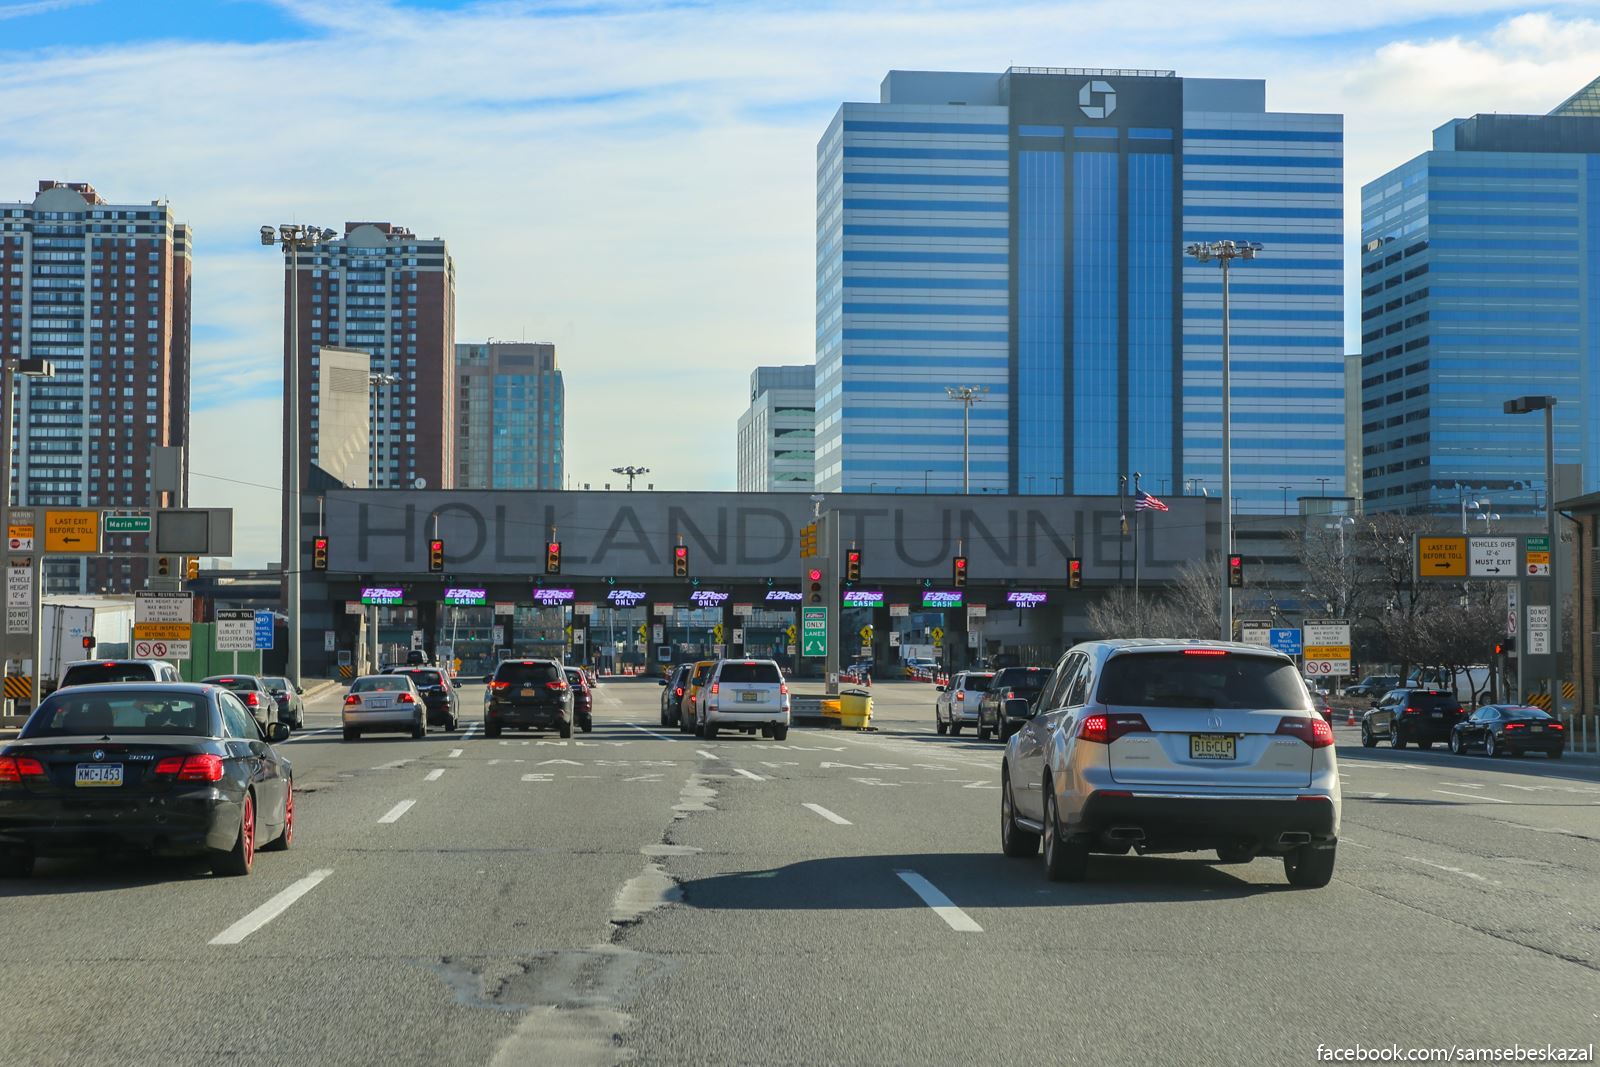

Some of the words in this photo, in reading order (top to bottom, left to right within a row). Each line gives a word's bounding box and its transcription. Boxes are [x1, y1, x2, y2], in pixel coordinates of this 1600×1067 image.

[358, 503, 793, 565] HOLLAND
[839, 509, 1186, 568] TUNNEL
[362, 588, 402, 597] E-ZPass
[446, 589, 485, 598] E-ZPass
[534, 589, 574, 599] E-ZPass
[608, 591, 647, 599] E-ZPass
[690, 591, 729, 600] E-ZPass
[844, 592, 883, 600] E-ZPass
[924, 592, 962, 600] E-ZPass
[1008, 592, 1046, 601] E-ZPass
